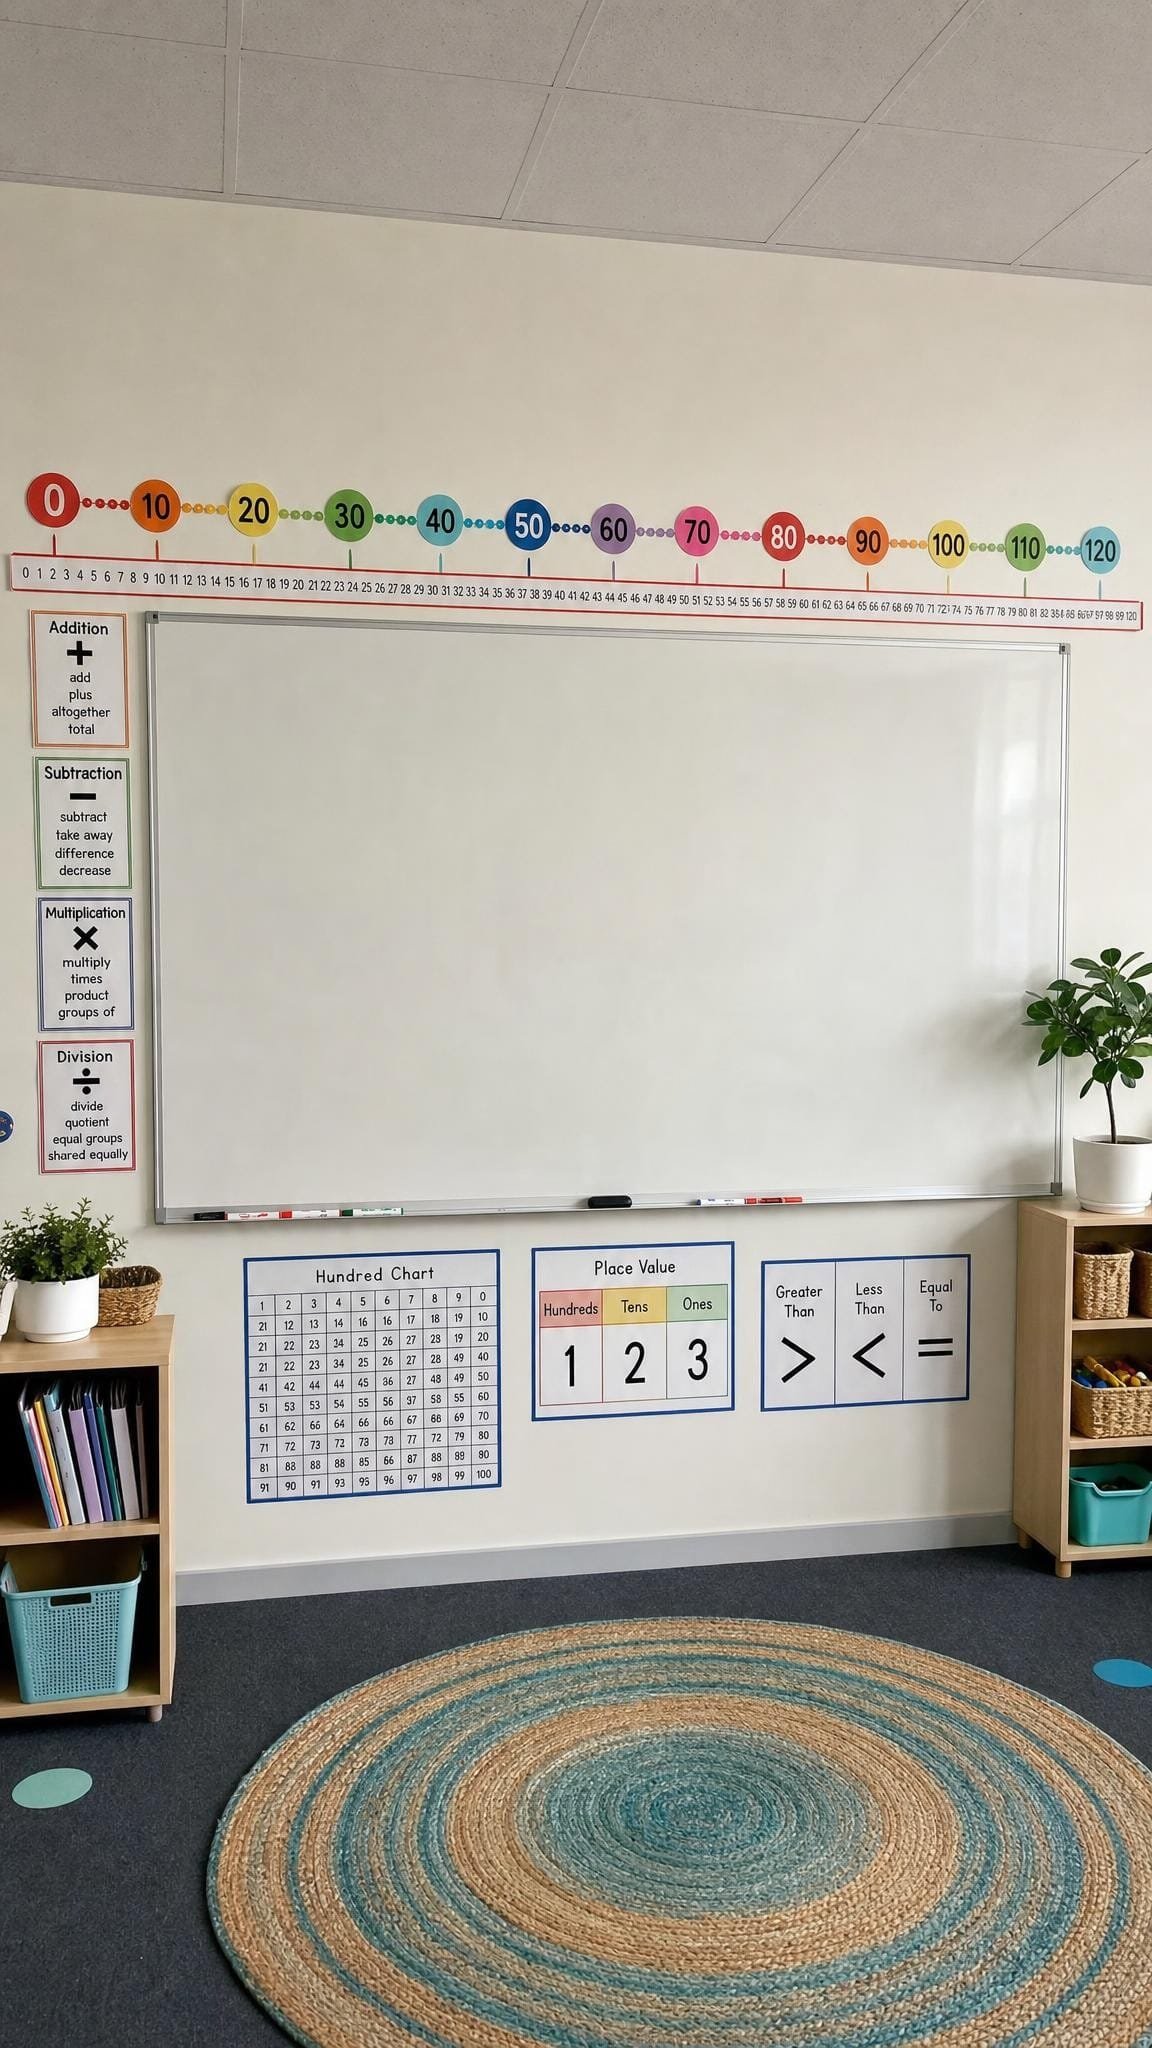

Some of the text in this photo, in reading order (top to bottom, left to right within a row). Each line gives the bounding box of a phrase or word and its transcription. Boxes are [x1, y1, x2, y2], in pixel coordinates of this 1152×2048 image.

[44, 484, 1116, 562] 0 10 20 30 40 50 60 70 80 90 100 110 120
[23, 567, 855, 610] 0 1 2 3 4 5 6 7 8 9 10 11 12 13 14 15 16 17 18 19 20 21 22 23 24 25 26 27 28 29 30 50 51 52 53 54 55 56 57 58 59 60 61 62 63 64
[49, 621, 108, 635] Addition
[70, 672, 91, 683] add
[69, 689, 92, 703] plus
[52, 706, 111, 720] altogether
[68, 724, 95, 735] total
[45, 766, 122, 780] Subtraction
[60, 811, 107, 822] subtract
[56, 829, 113, 843] take away
[55, 847, 114, 859] difference
[59, 865, 111, 876] decrease
[46, 906, 126, 922] Multiplication
[63, 957, 111, 970] multiply
[71, 974, 103, 984] times
[65, 990, 109, 1004] product
[58, 1006, 116, 1021] groups of
[57, 1050, 113, 1063] Division
[71, 1101, 103, 1112] divide
[65, 1117, 109, 1130] quotient
[53, 1133, 123, 1146] equal groups
[48, 1148, 128, 1162] shared equally
[316, 1266, 434, 1283] Hundred Chart
[595, 1259, 675, 1276] Place Value
[776, 1285, 823, 1299] Greater
[856, 1283, 883, 1296] Less
[920, 1279, 953, 1297] Equal
[260, 1291, 486, 1311] 1 2 3 4 5 6 7 8 9 0
[544, 1297, 713, 1317] Hundreds Tens Ones
[929, 1299, 943, 1312] To
[784, 1304, 814, 1318] Than
[855, 1302, 885, 1315] Than
[259, 1312, 488, 1331] 21 12 13 14 16 16 17 18 19 10
[259, 1352, 489, 1372] 21 22 23 34 25 26 27 28 49 40
[565, 1338, 708, 1387] 1 2 3
[259, 1371, 489, 1392] 41 42 44 44 49 50
[260, 1441, 296, 1453] 71 72
[260, 1469, 492, 1493] 91 90 97 98 99 100
